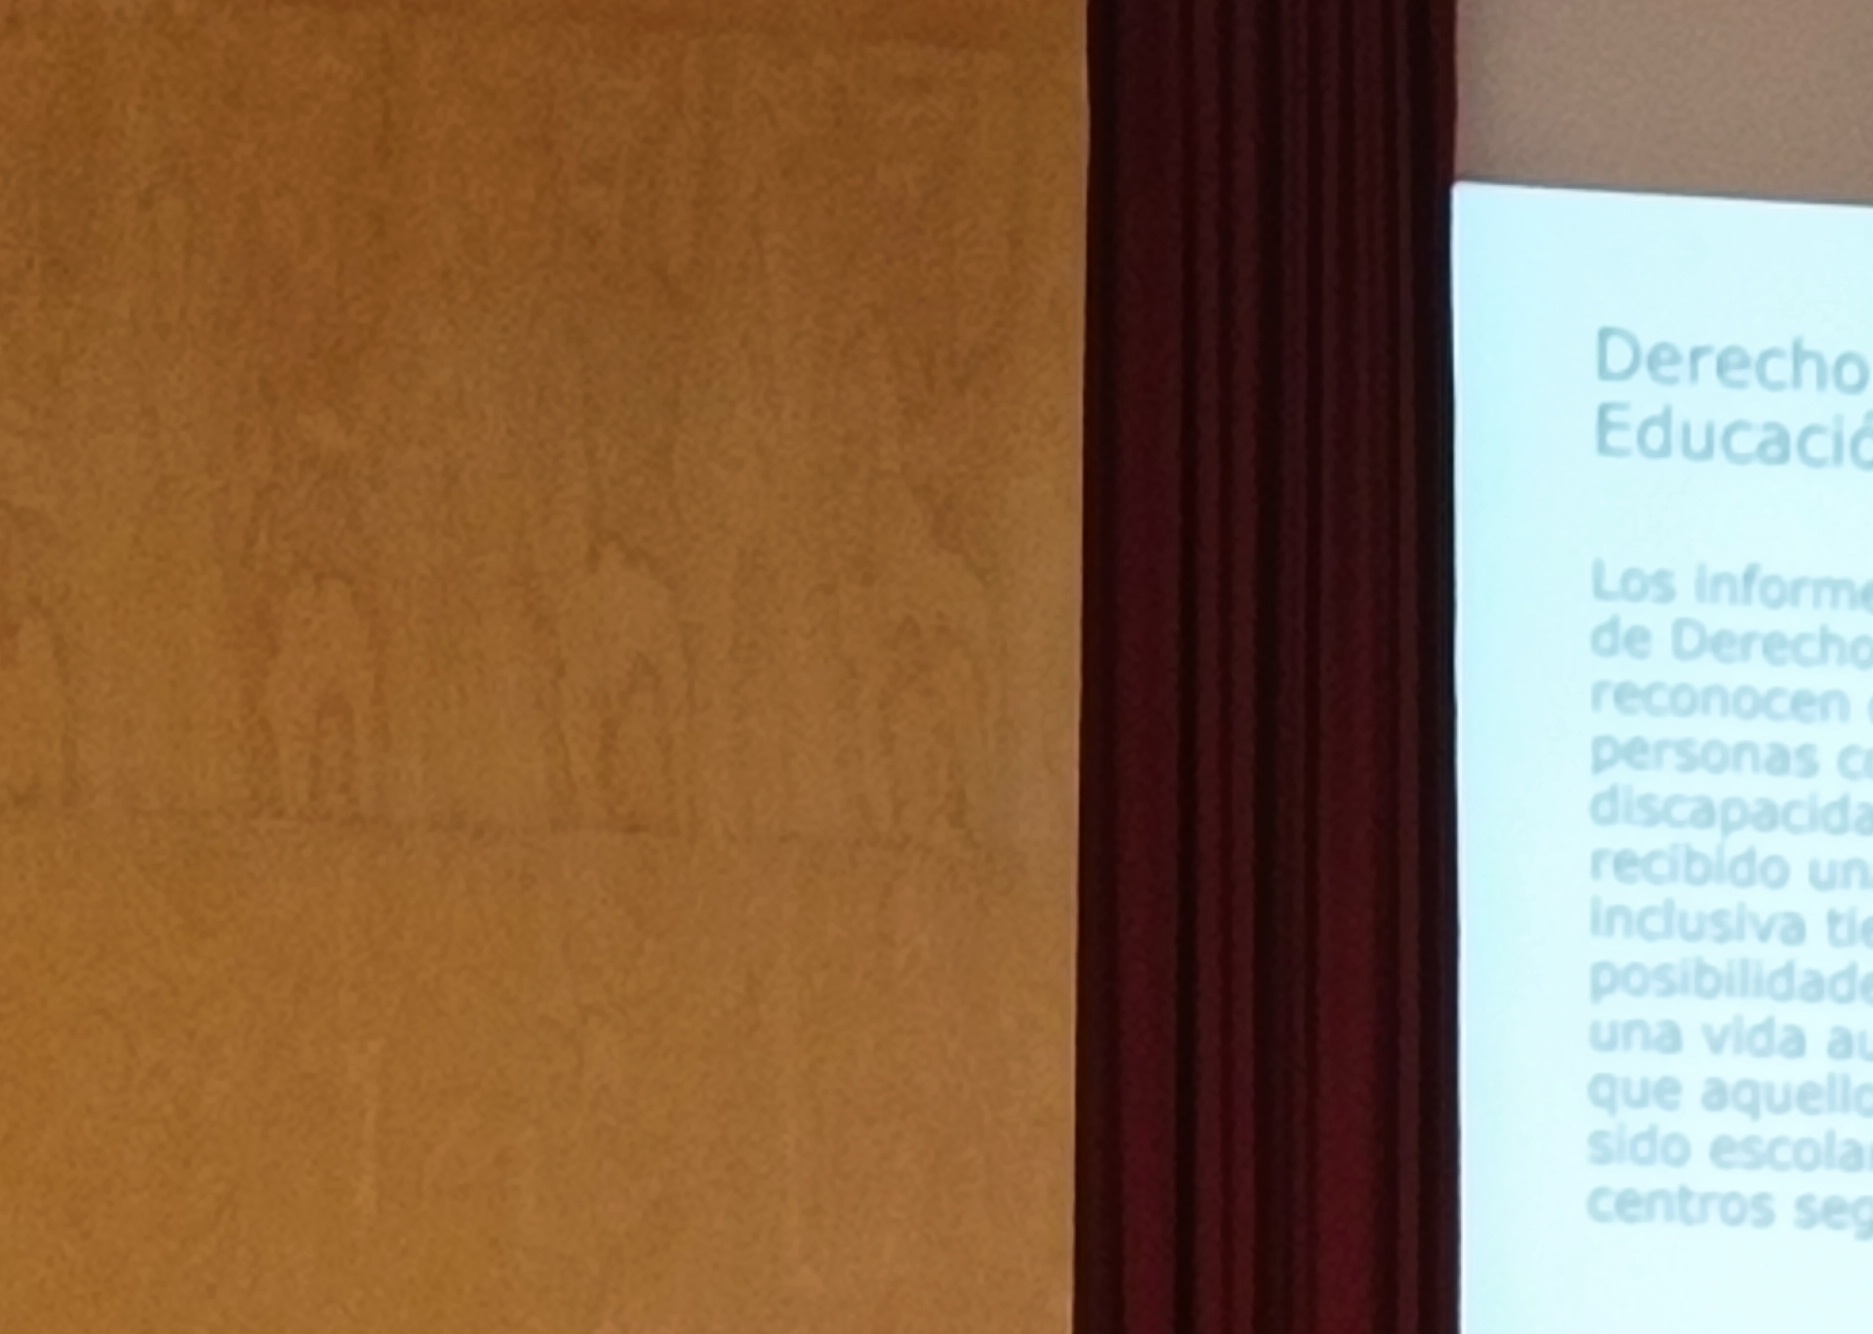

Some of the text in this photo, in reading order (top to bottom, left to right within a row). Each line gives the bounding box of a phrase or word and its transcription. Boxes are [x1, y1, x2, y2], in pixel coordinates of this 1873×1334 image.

[1596, 325, 1871, 395] Derecho
[1592, 558, 1677, 604] Los
[1589, 615, 1652, 661] de
[1590, 679, 1851, 724] reconocen
[1590, 733, 1820, 779] personas
[1591, 841, 1790, 890] recibido
[1591, 895, 1806, 947] inclusiva
[1588, 1017, 1683, 1055] una
[1701, 1013, 1806, 1061] vida
[1586, 1070, 1683, 1116] que
[1586, 1123, 1692, 1168] sido
[1586, 1184, 1776, 1229] centros
